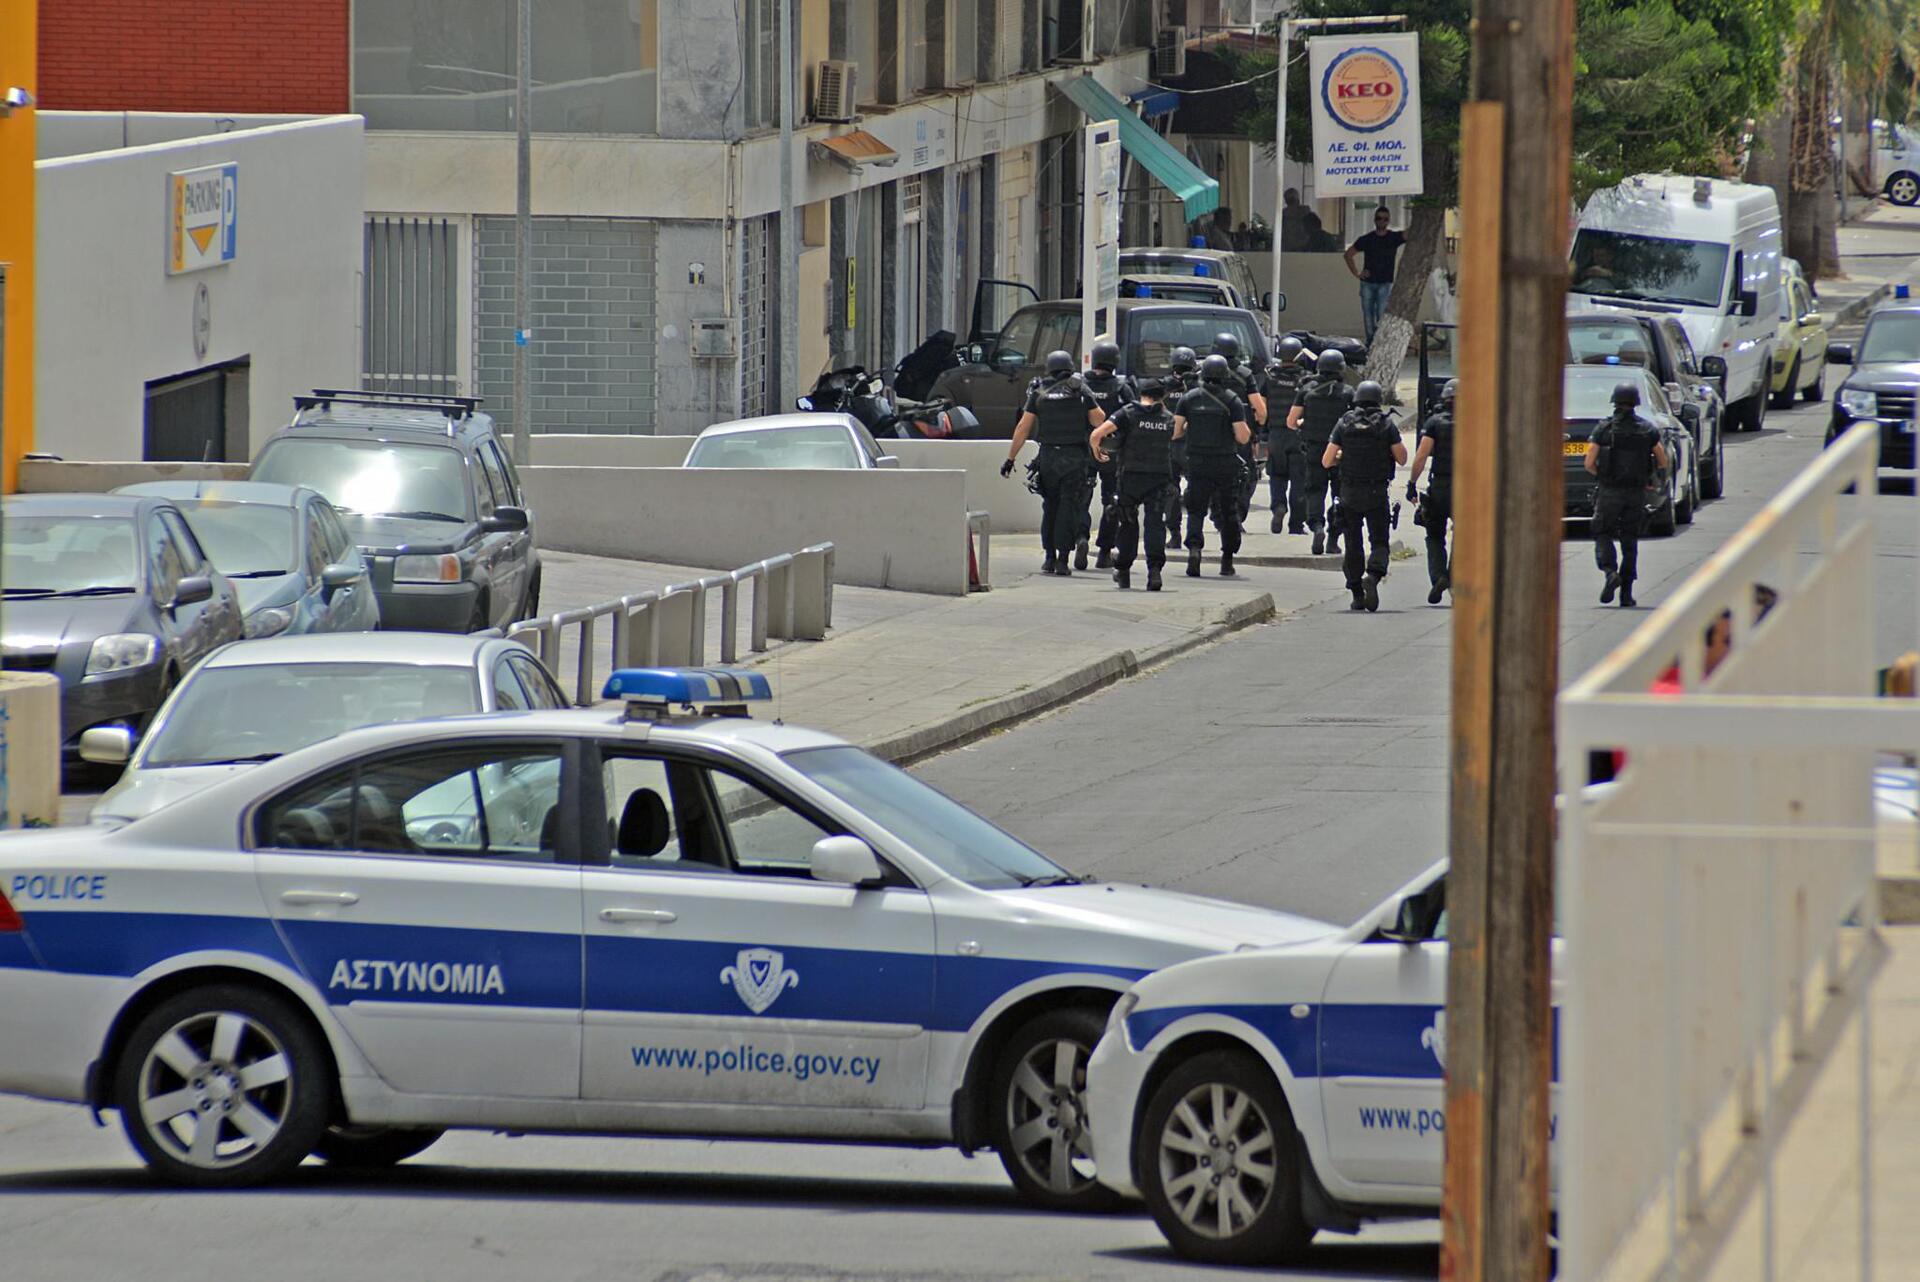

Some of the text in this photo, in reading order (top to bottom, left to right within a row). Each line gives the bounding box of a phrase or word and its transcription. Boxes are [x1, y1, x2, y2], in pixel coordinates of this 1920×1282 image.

[1337, 82, 1393, 98] KEO
[1328, 140, 1406, 153] ΛΕ. ΦΙ. ΜΟΛ.
[1333, 154, 1402, 164] ΛΕΣΧΗ ΦΙΛΩΝ
[1345, 176, 1391, 185] ΛΕΜΕΣΟΥ
[184, 179, 220, 215] PARKING
[1139, 421, 1168, 431] POLICE
[1565, 443, 1585, 454] 538
[10, 875, 107, 900] POLICE
[328, 959, 505, 995] ΑΣΤΥΝΟΜΙΑ
[631, 1045, 881, 1084] www.police.gov.cy
